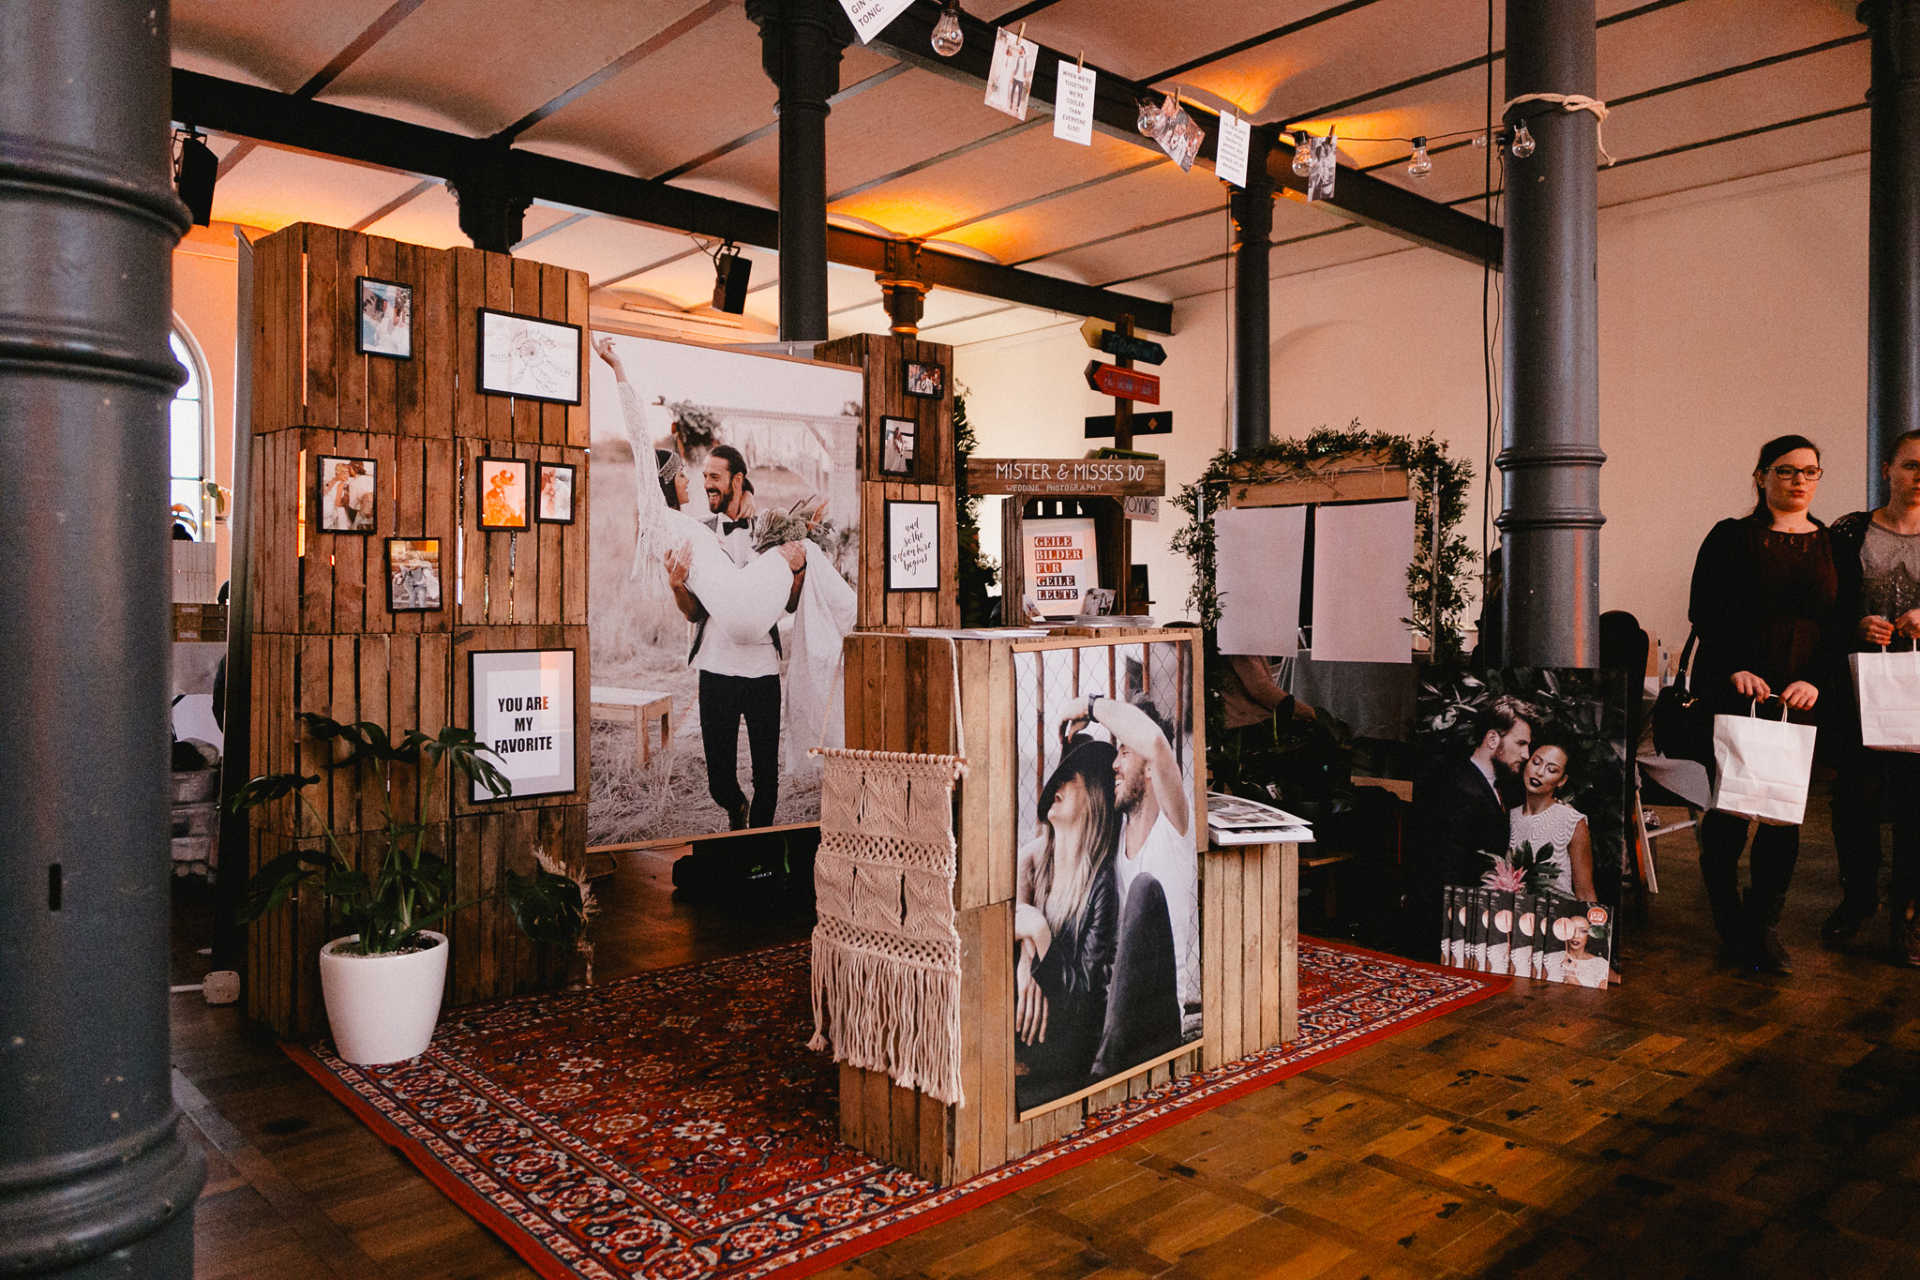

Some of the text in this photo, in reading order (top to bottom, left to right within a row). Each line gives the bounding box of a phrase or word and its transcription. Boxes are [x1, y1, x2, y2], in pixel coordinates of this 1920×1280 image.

[851, 0, 866, 14] GIN
[995, 463, 1145, 482] MISTER & MISSES DO
[1006, 483, 1104, 493] WEDDING PHOTOGRAPHY
[1034, 536, 1072, 547] GEILE
[1035, 549, 1083, 560] BILDER
[1037, 575, 1075, 587] GEILE
[1037, 588, 1078, 600] LEUTE
[498, 696, 549, 713] YOU ARE
[514, 717, 533, 732] MY
[494, 736, 553, 754] FAVORITE
